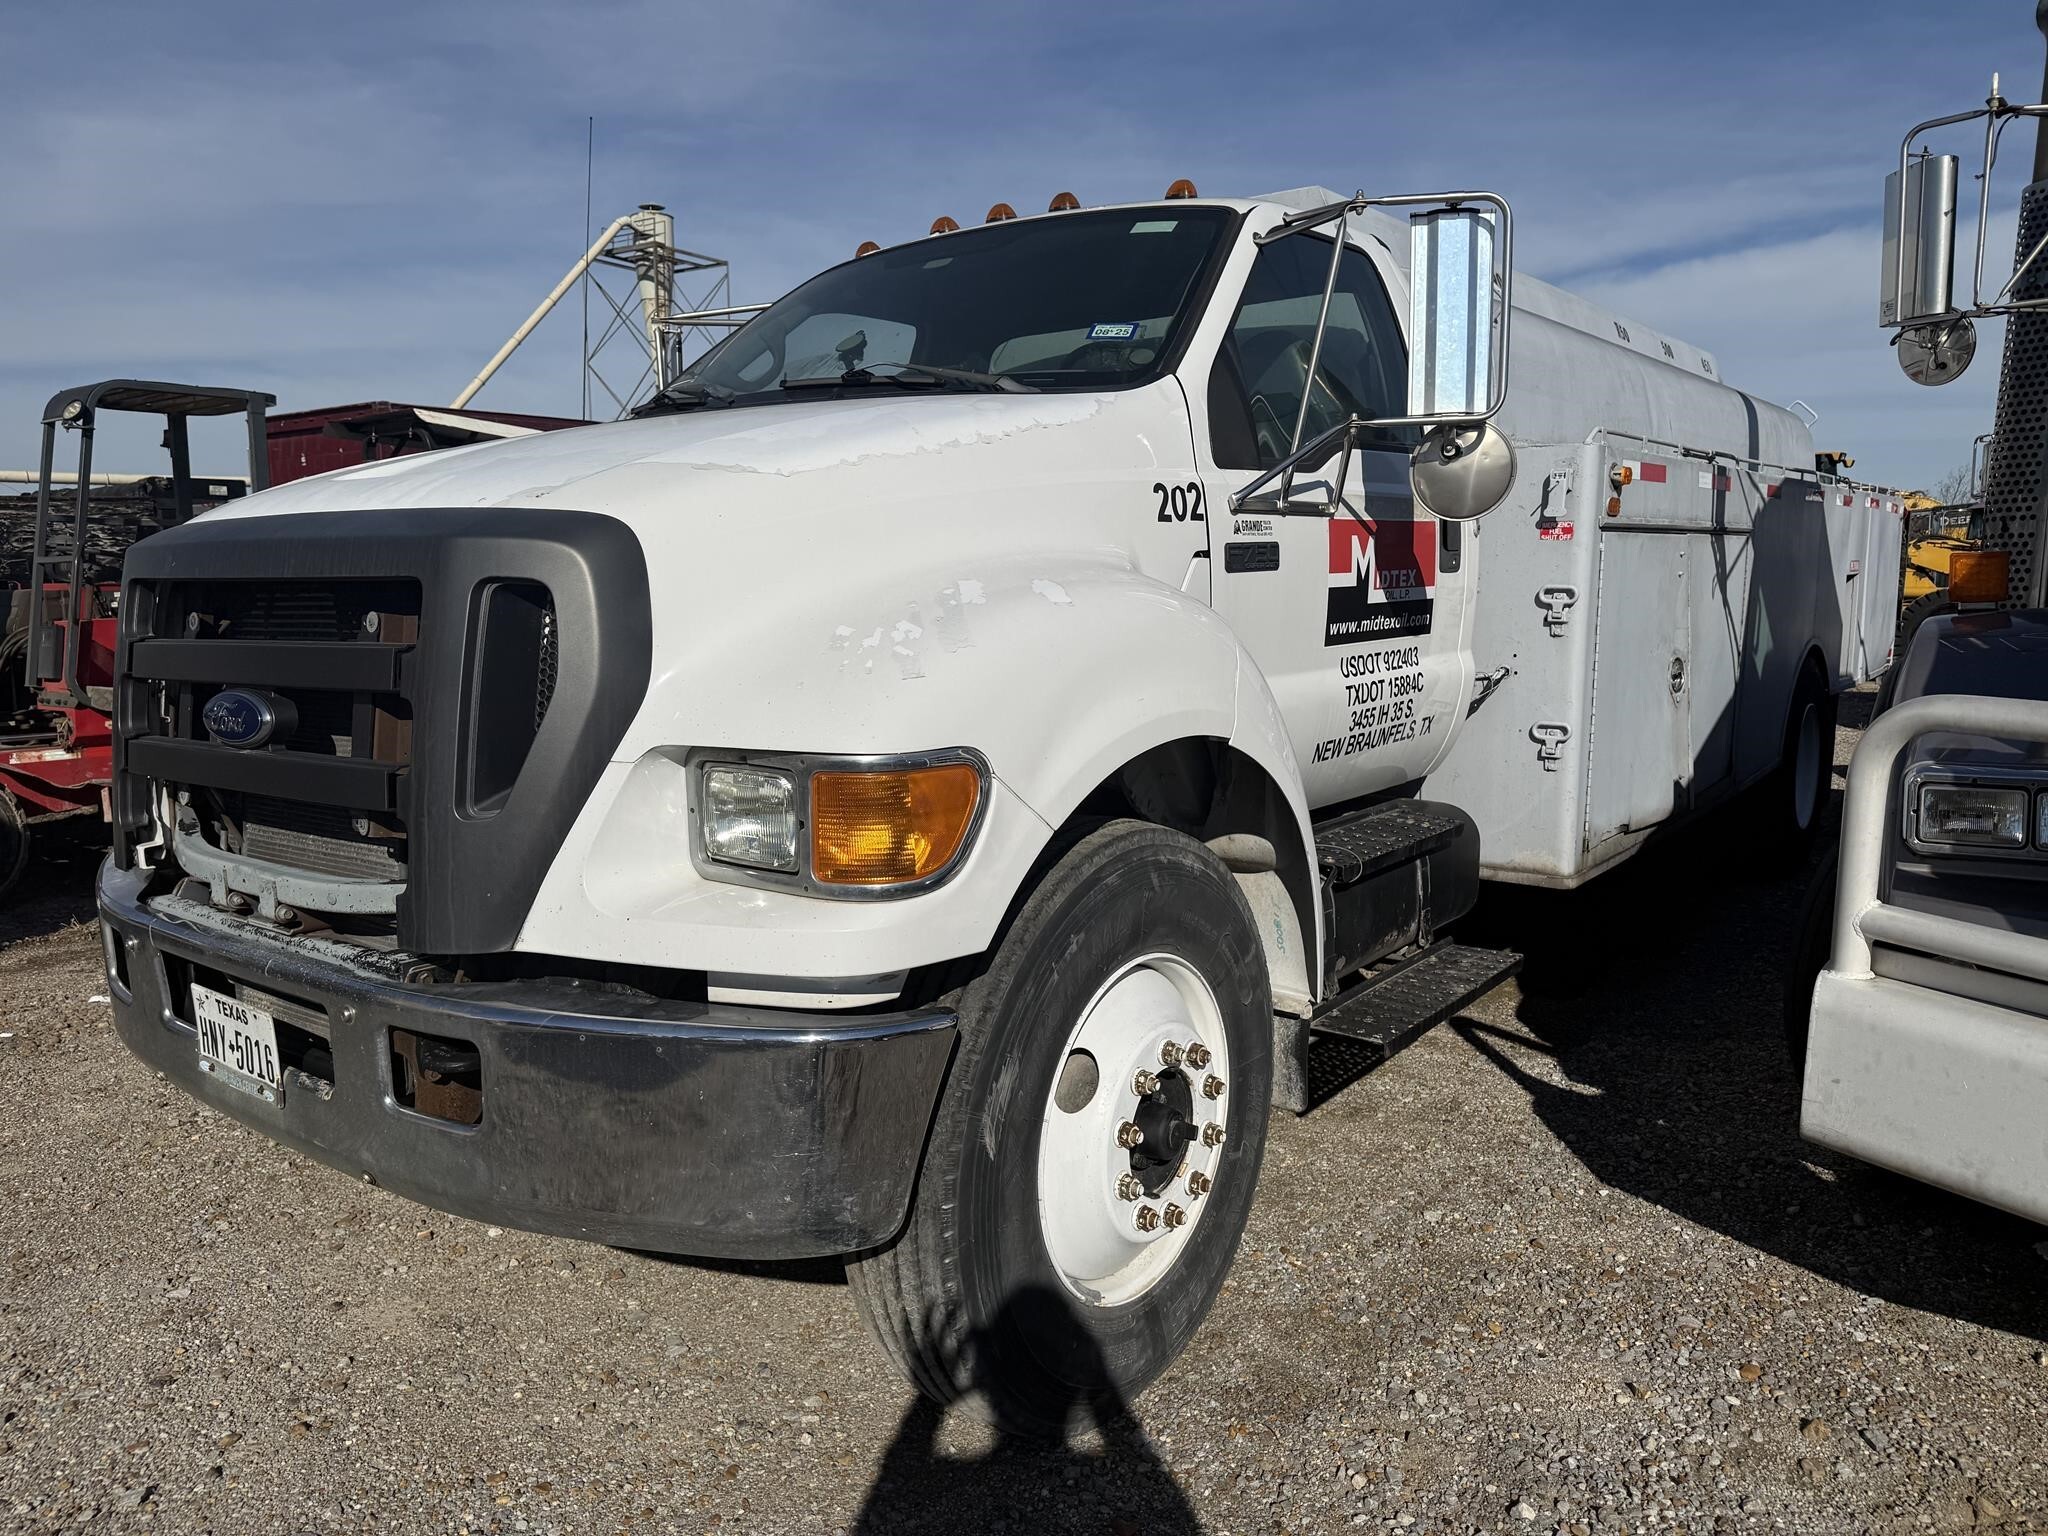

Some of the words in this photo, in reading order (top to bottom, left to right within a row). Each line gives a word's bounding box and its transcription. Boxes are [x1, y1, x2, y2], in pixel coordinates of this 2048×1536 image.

[1153, 481, 1205, 522] 202
[1241, 520, 1263, 532] GRANDE
[1549, 527, 1564, 535] FUEL
[1329, 613, 1430, 636] www.midtexoil.com
[1340, 652, 1382, 678] USDOT
[1383, 646, 1419, 671] 922403
[1345, 679, 1385, 707] TXDOT
[1388, 672, 1424, 698] 15884C
[207, 701, 247, 733] Ford
[1349, 707, 1377, 732] 3455
[1377, 703, 1390, 725] IH
[1391, 700, 1404, 722] 35
[1405, 698, 1414, 719] S.
[1311, 736, 1347, 764] NEW
[1344, 720, 1416, 756] BRAUNFELS,
[1420, 715, 1436, 737] TX
[214, 998, 249, 1026] TEXAS
